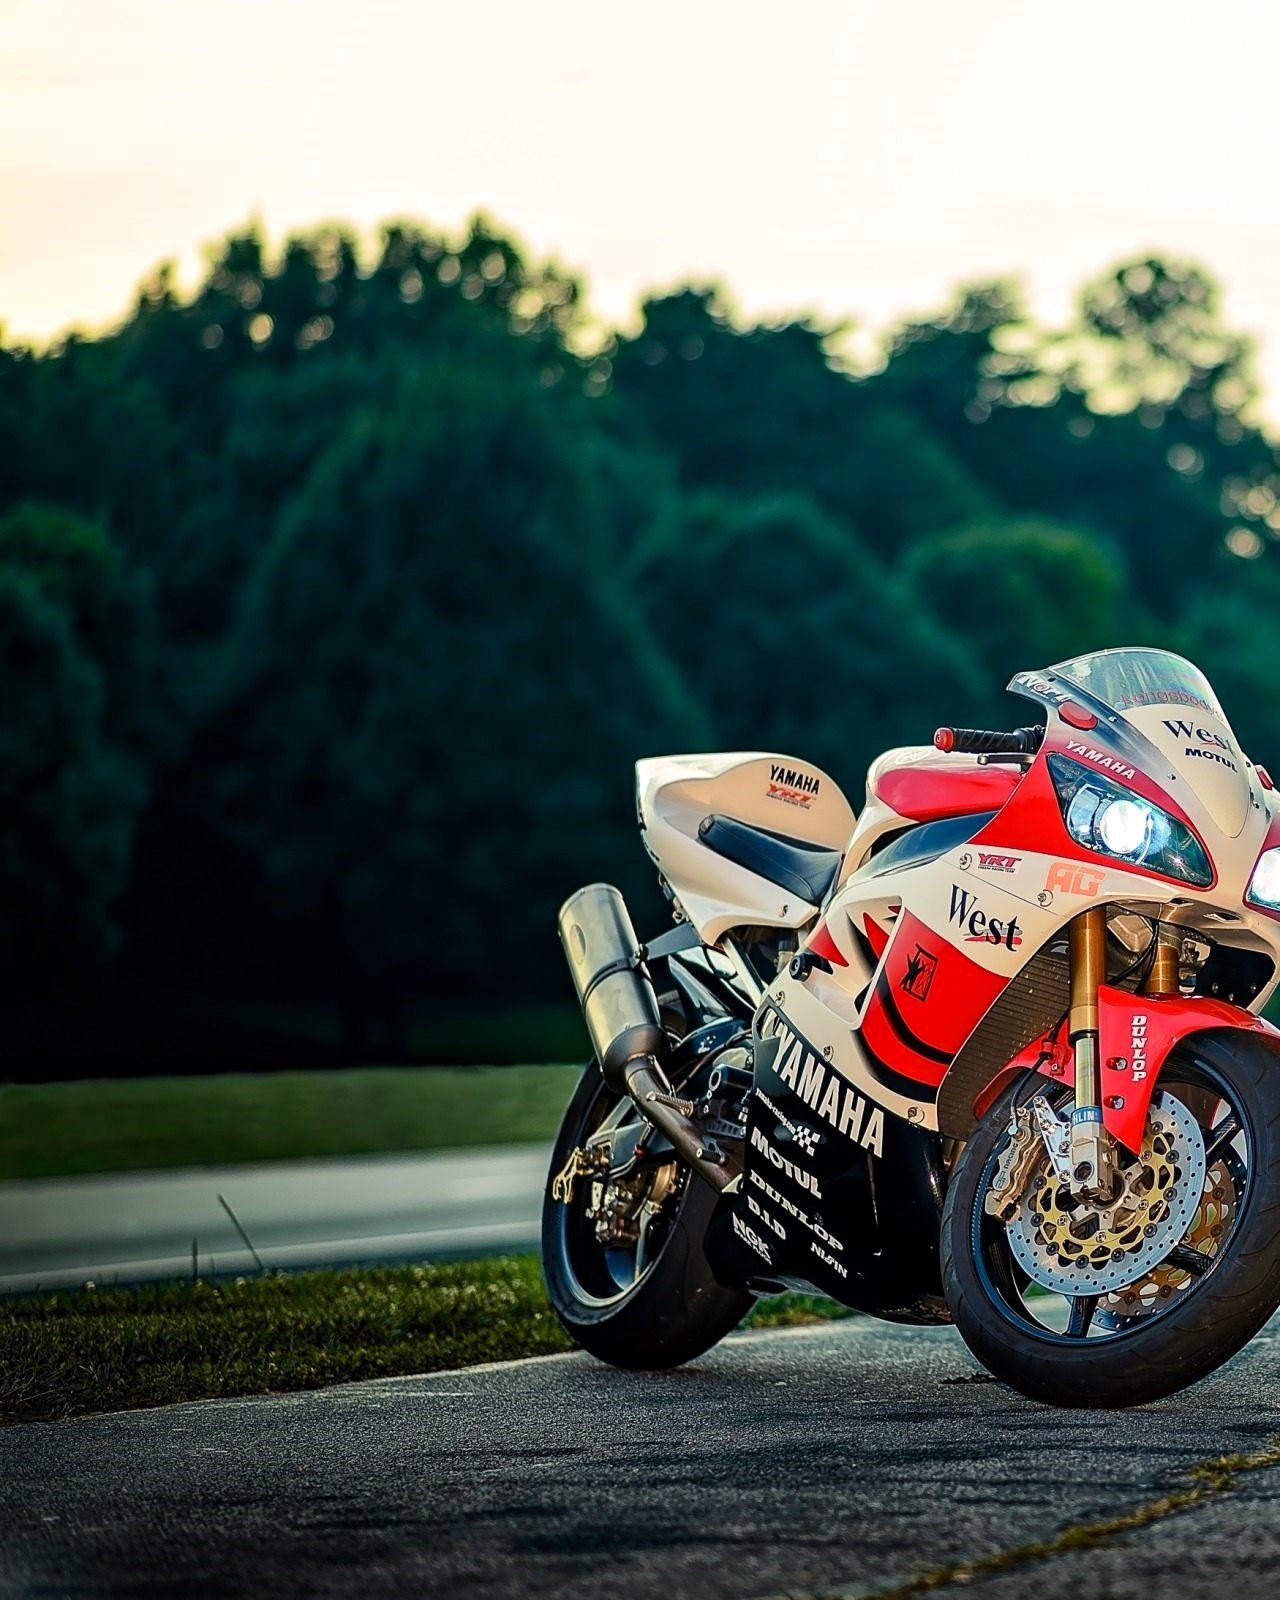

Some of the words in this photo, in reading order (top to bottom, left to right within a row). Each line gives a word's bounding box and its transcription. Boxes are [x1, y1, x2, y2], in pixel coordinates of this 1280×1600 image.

[1065, 740, 1136, 780] YAMAHA
[1161, 719, 1238, 759] West
[1184, 747, 1238, 773] MOTUL
[770, 764, 820, 795] YAMAHA
[978, 852, 1023, 868] YRT
[1045, 861, 1106, 897] AG
[949, 883, 1018, 951] West
[1131, 1015, 1147, 1082] DUNLOP
[772, 1022, 884, 1158] YAMAHA
[750, 1126, 822, 1199] MOTUL
[747, 1195, 786, 1240] D.I.D
[749, 1169, 844, 1250] DUNLOP
[732, 1211, 771, 1259] NGK
